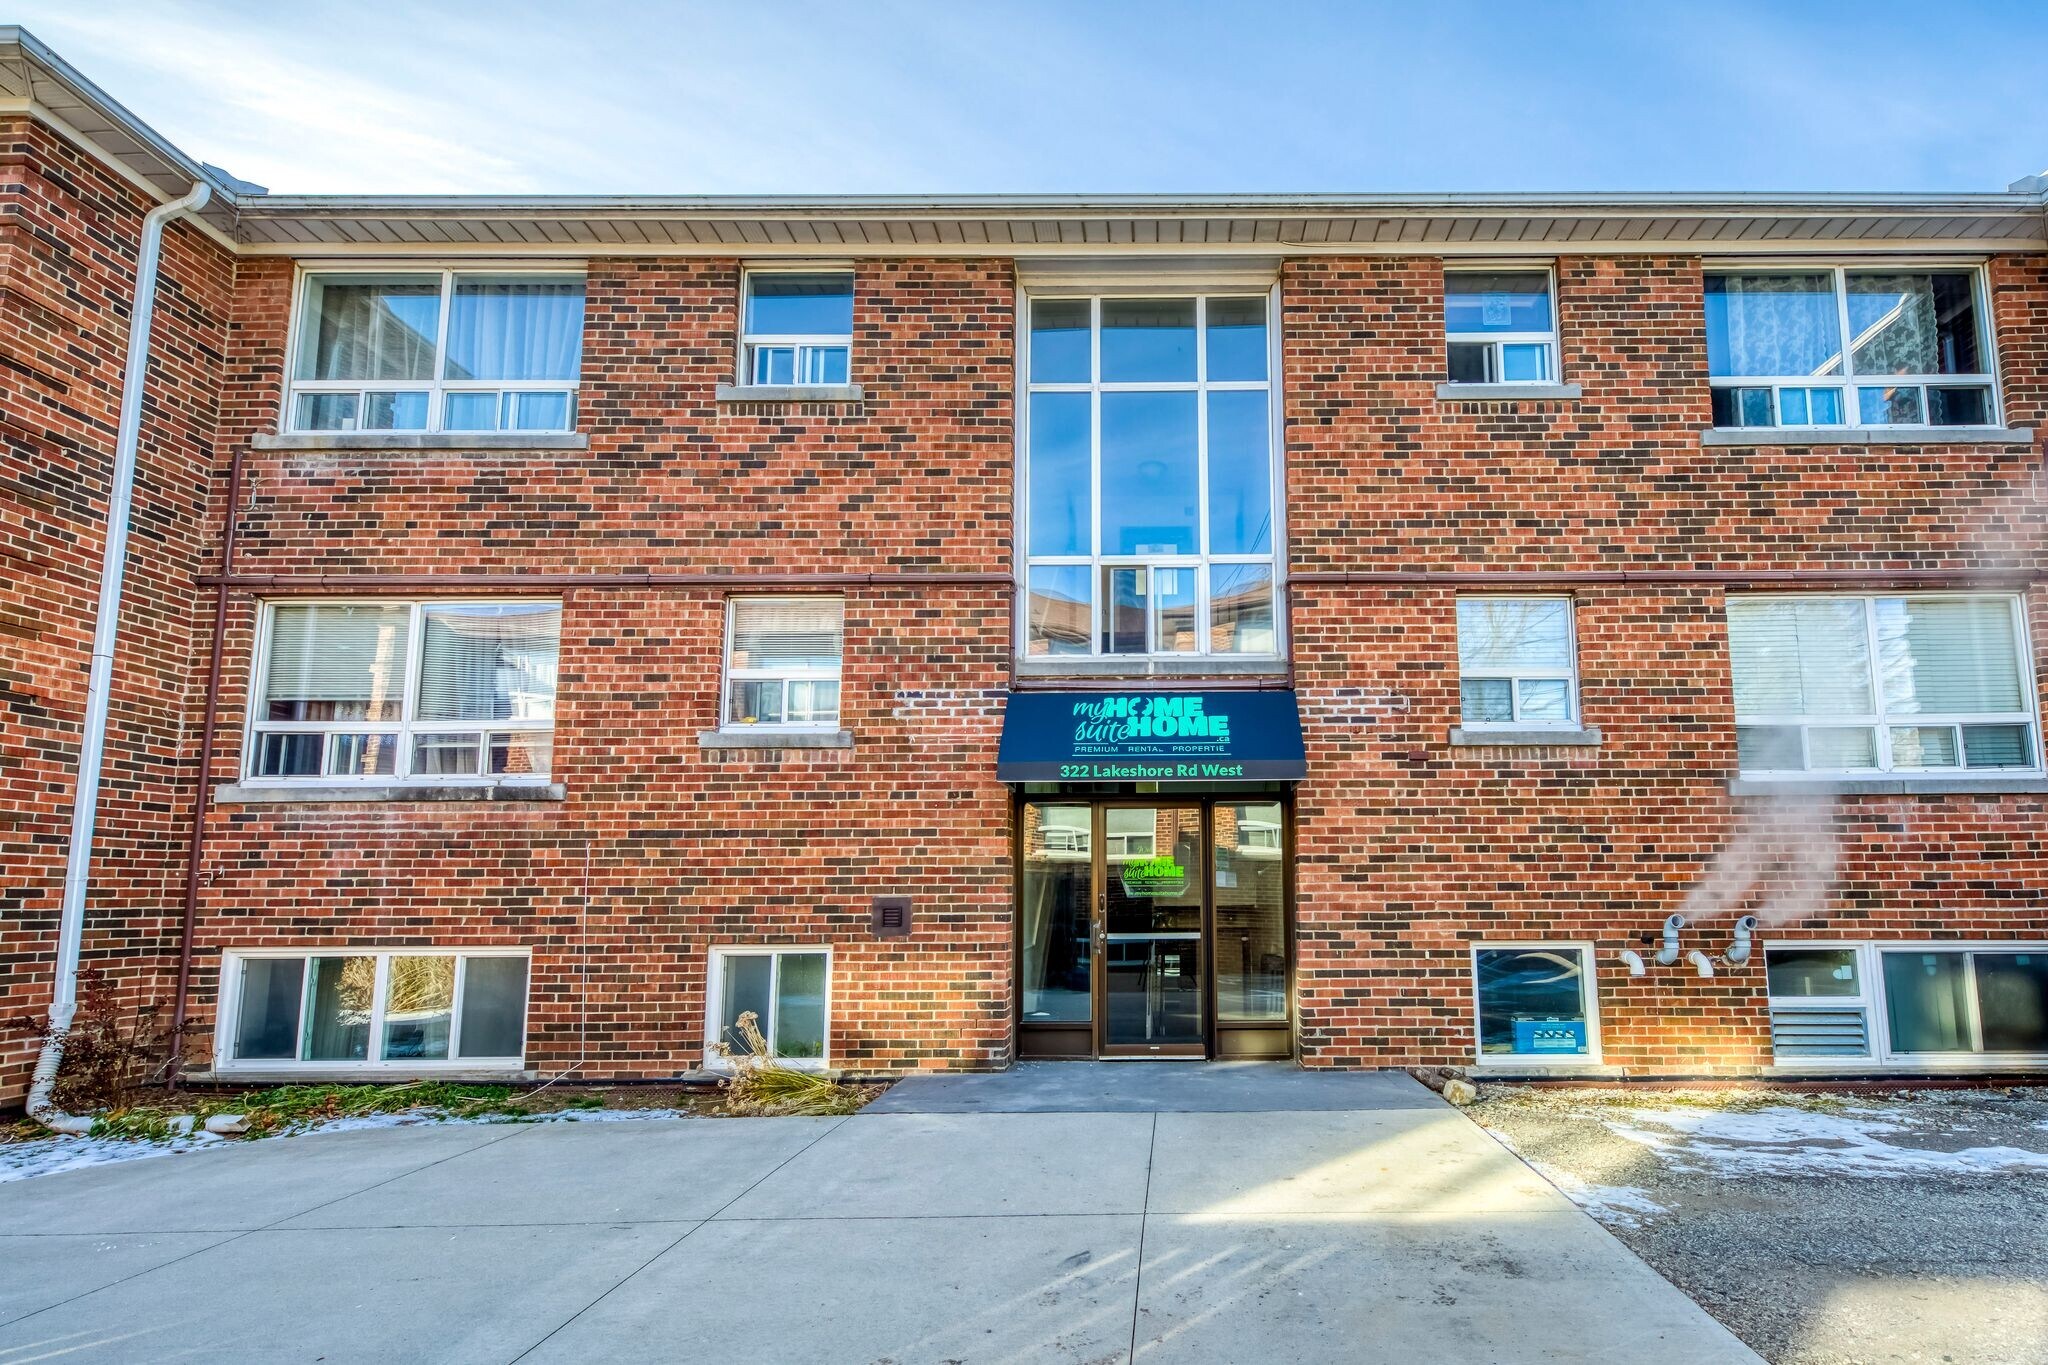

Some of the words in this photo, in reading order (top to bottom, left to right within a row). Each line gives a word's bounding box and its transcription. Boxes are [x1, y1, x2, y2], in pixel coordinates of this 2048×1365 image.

[1075, 719, 1131, 742] suite
[1127, 715, 1230, 737] HOME
[1060, 765, 1090, 777] 322
[1093, 764, 1174, 777] Lakeshore
[1177, 764, 1198, 777] Rd
[1202, 764, 1243, 777] West
[1143, 865, 1185, 877] HOME
